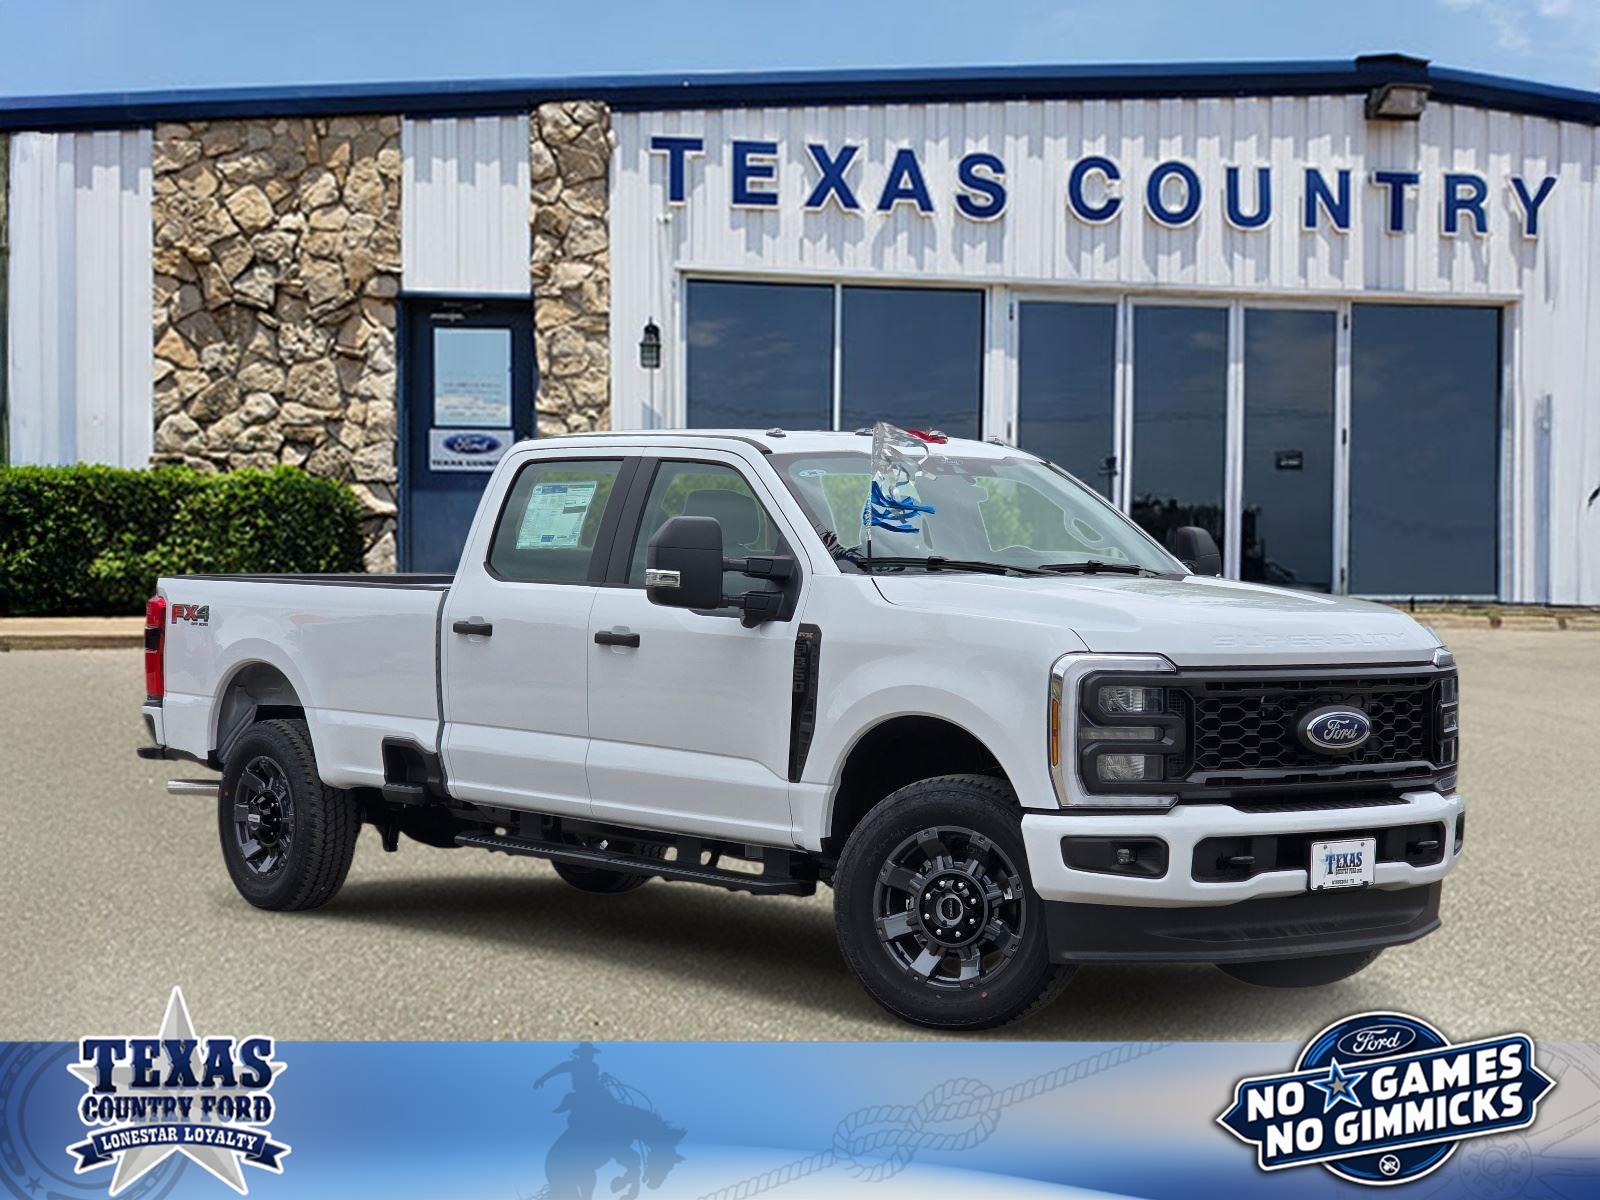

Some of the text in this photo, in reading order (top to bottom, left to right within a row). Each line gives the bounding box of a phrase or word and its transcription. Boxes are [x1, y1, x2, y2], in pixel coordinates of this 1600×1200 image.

[650, 135, 1557, 240] TEXAS COUNTRY
[172, 604, 209, 624] FX4
[1213, 631, 1405, 648] SUPER DUTY
[1323, 719, 1358, 741] Ford
[1325, 851, 1362, 874] TEXAS
